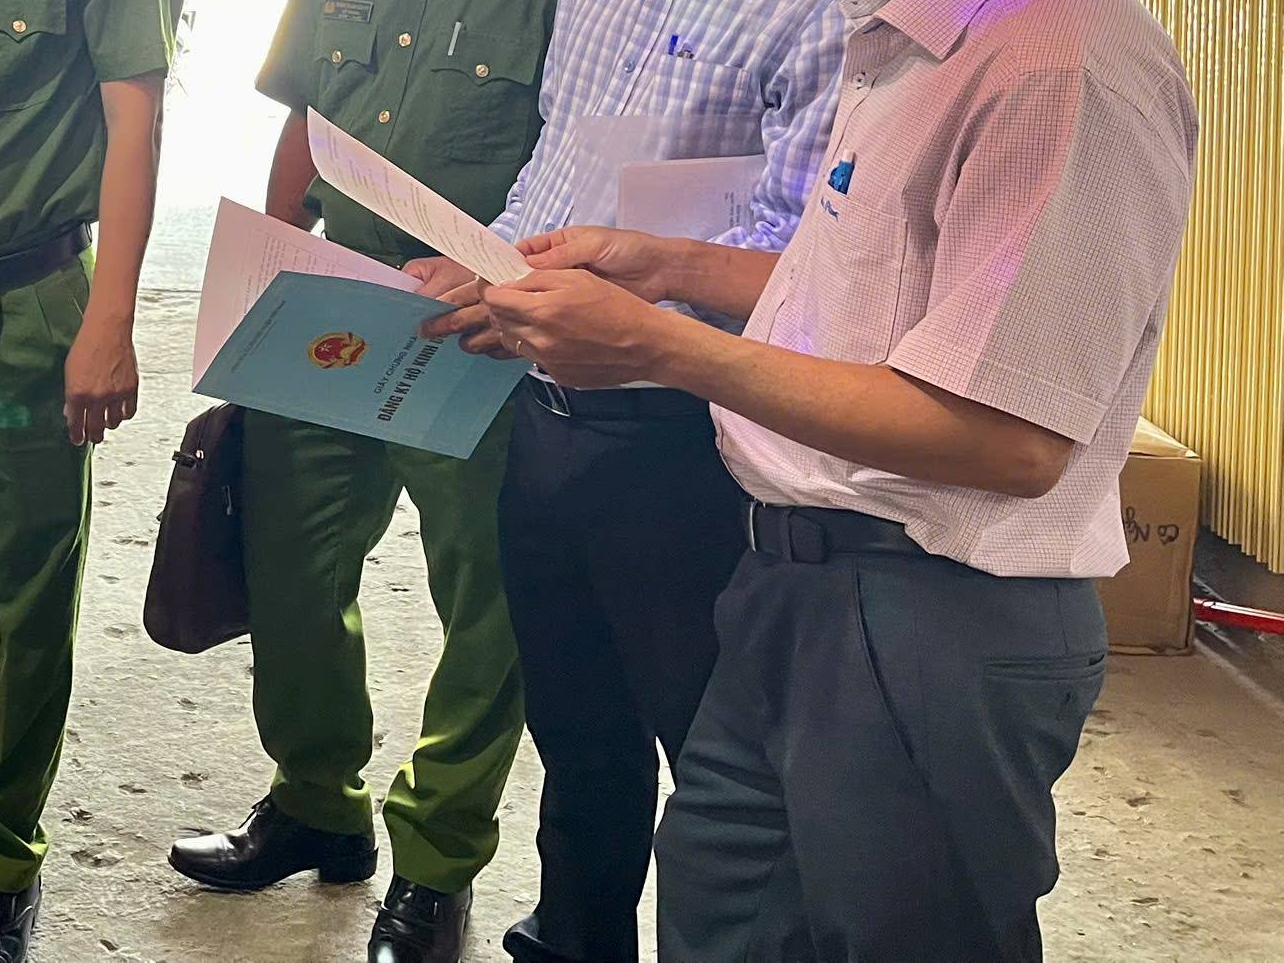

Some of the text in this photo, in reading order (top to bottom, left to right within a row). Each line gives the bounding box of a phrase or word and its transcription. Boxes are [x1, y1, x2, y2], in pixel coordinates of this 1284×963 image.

[412, 344, 439, 367] KINH
[403, 367, 424, 382] HỘ
[377, 395, 404, 422] ĐĂNG
